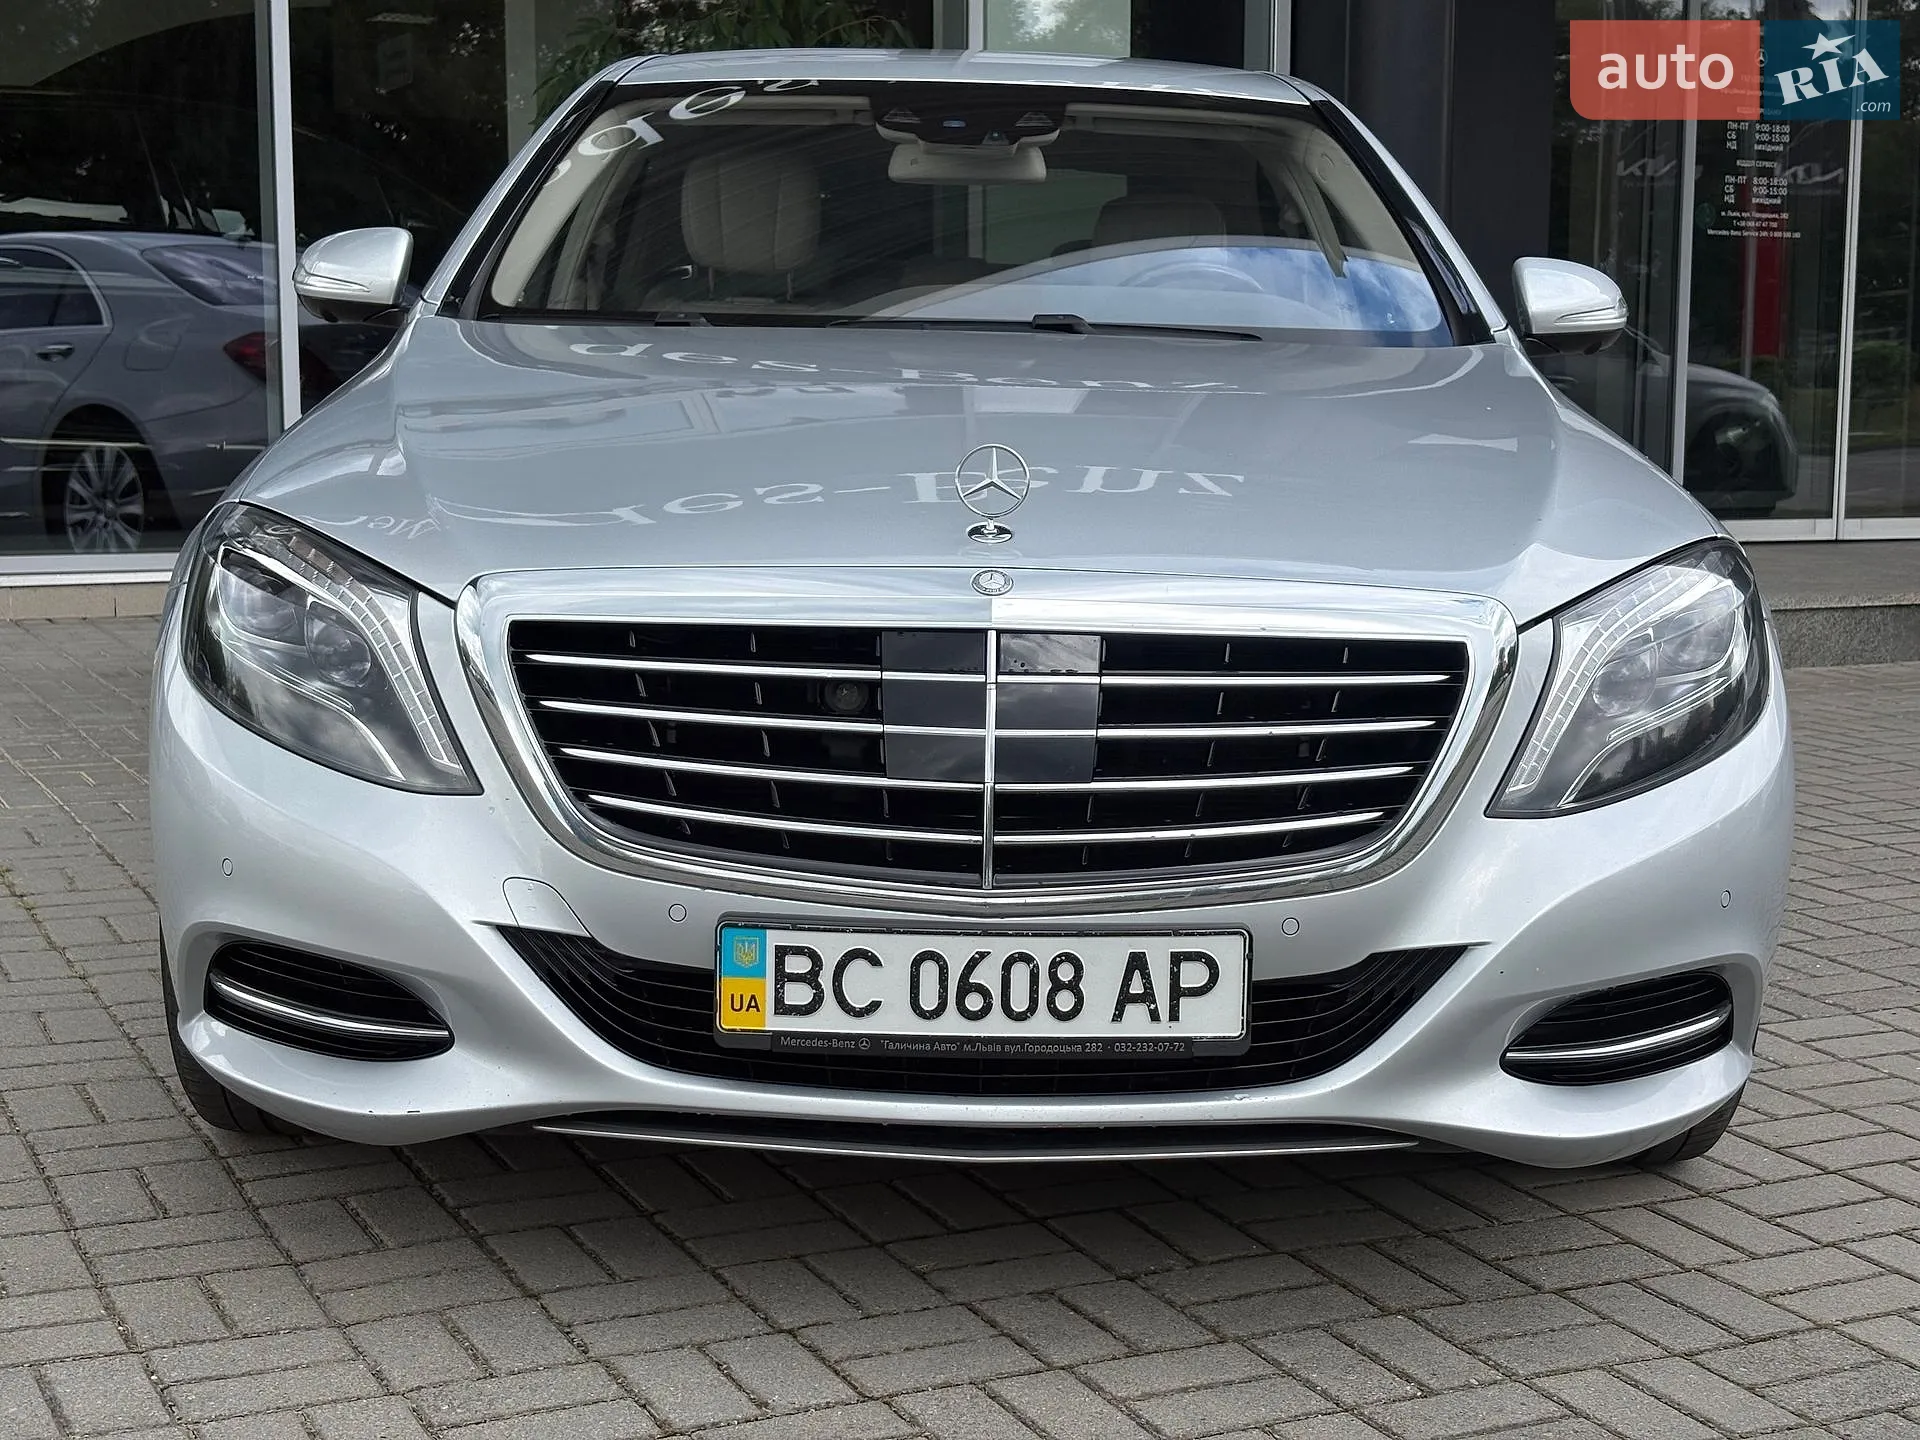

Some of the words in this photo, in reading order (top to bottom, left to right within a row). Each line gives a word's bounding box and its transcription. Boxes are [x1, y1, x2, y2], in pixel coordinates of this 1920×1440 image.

[1727, 121, 1749, 130] ПН-ПТ
[1755, 123, 1790, 133] 9:00-18:00
[1726, 131, 1737, 139] СБ
[1755, 133, 1790, 143] 9:00-15:00
[1725, 175, 1747, 184] ПН-ПТ
[1724, 185, 1734, 193] СБ
[1753, 187, 1788, 196] 9:00-15:00
[1724, 194, 1735, 204] НД
[774, 945, 883, 1017] BC
[910, 949, 1085, 1022] 0608
[1111, 950, 1221, 1023] AP
[731, 993, 760, 1012] UA
[781, 1037, 855, 1049] Mercedes-Benz
[1085, 1042, 1103, 1052] 282
[1114, 1042, 1185, 1053] 032-232-07-72
